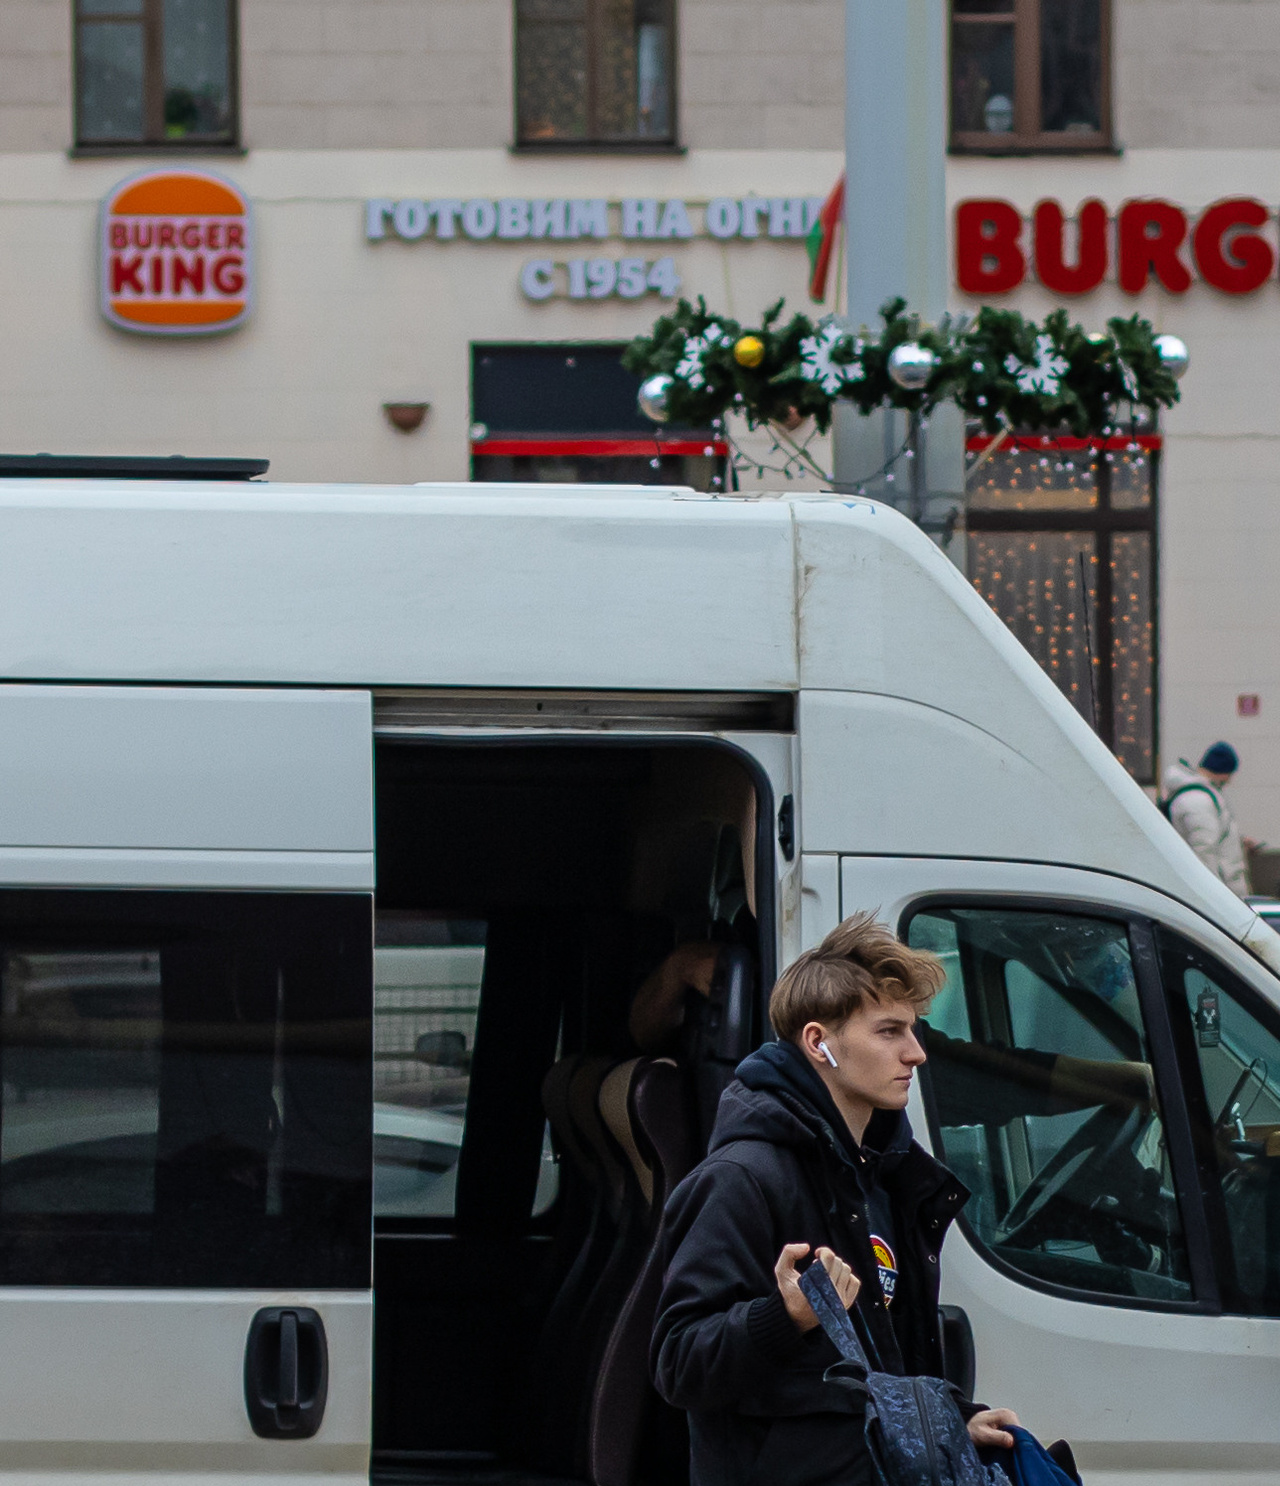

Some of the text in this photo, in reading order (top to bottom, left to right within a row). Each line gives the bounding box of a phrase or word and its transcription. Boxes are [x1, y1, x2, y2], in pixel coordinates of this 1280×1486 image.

[111, 223, 245, 249] BURGER
[366, 198, 608, 240] ГОТОВИМ
[622, 198, 694, 240] НА
[111, 254, 246, 295] KING
[522, 256, 681, 300] С 1954
